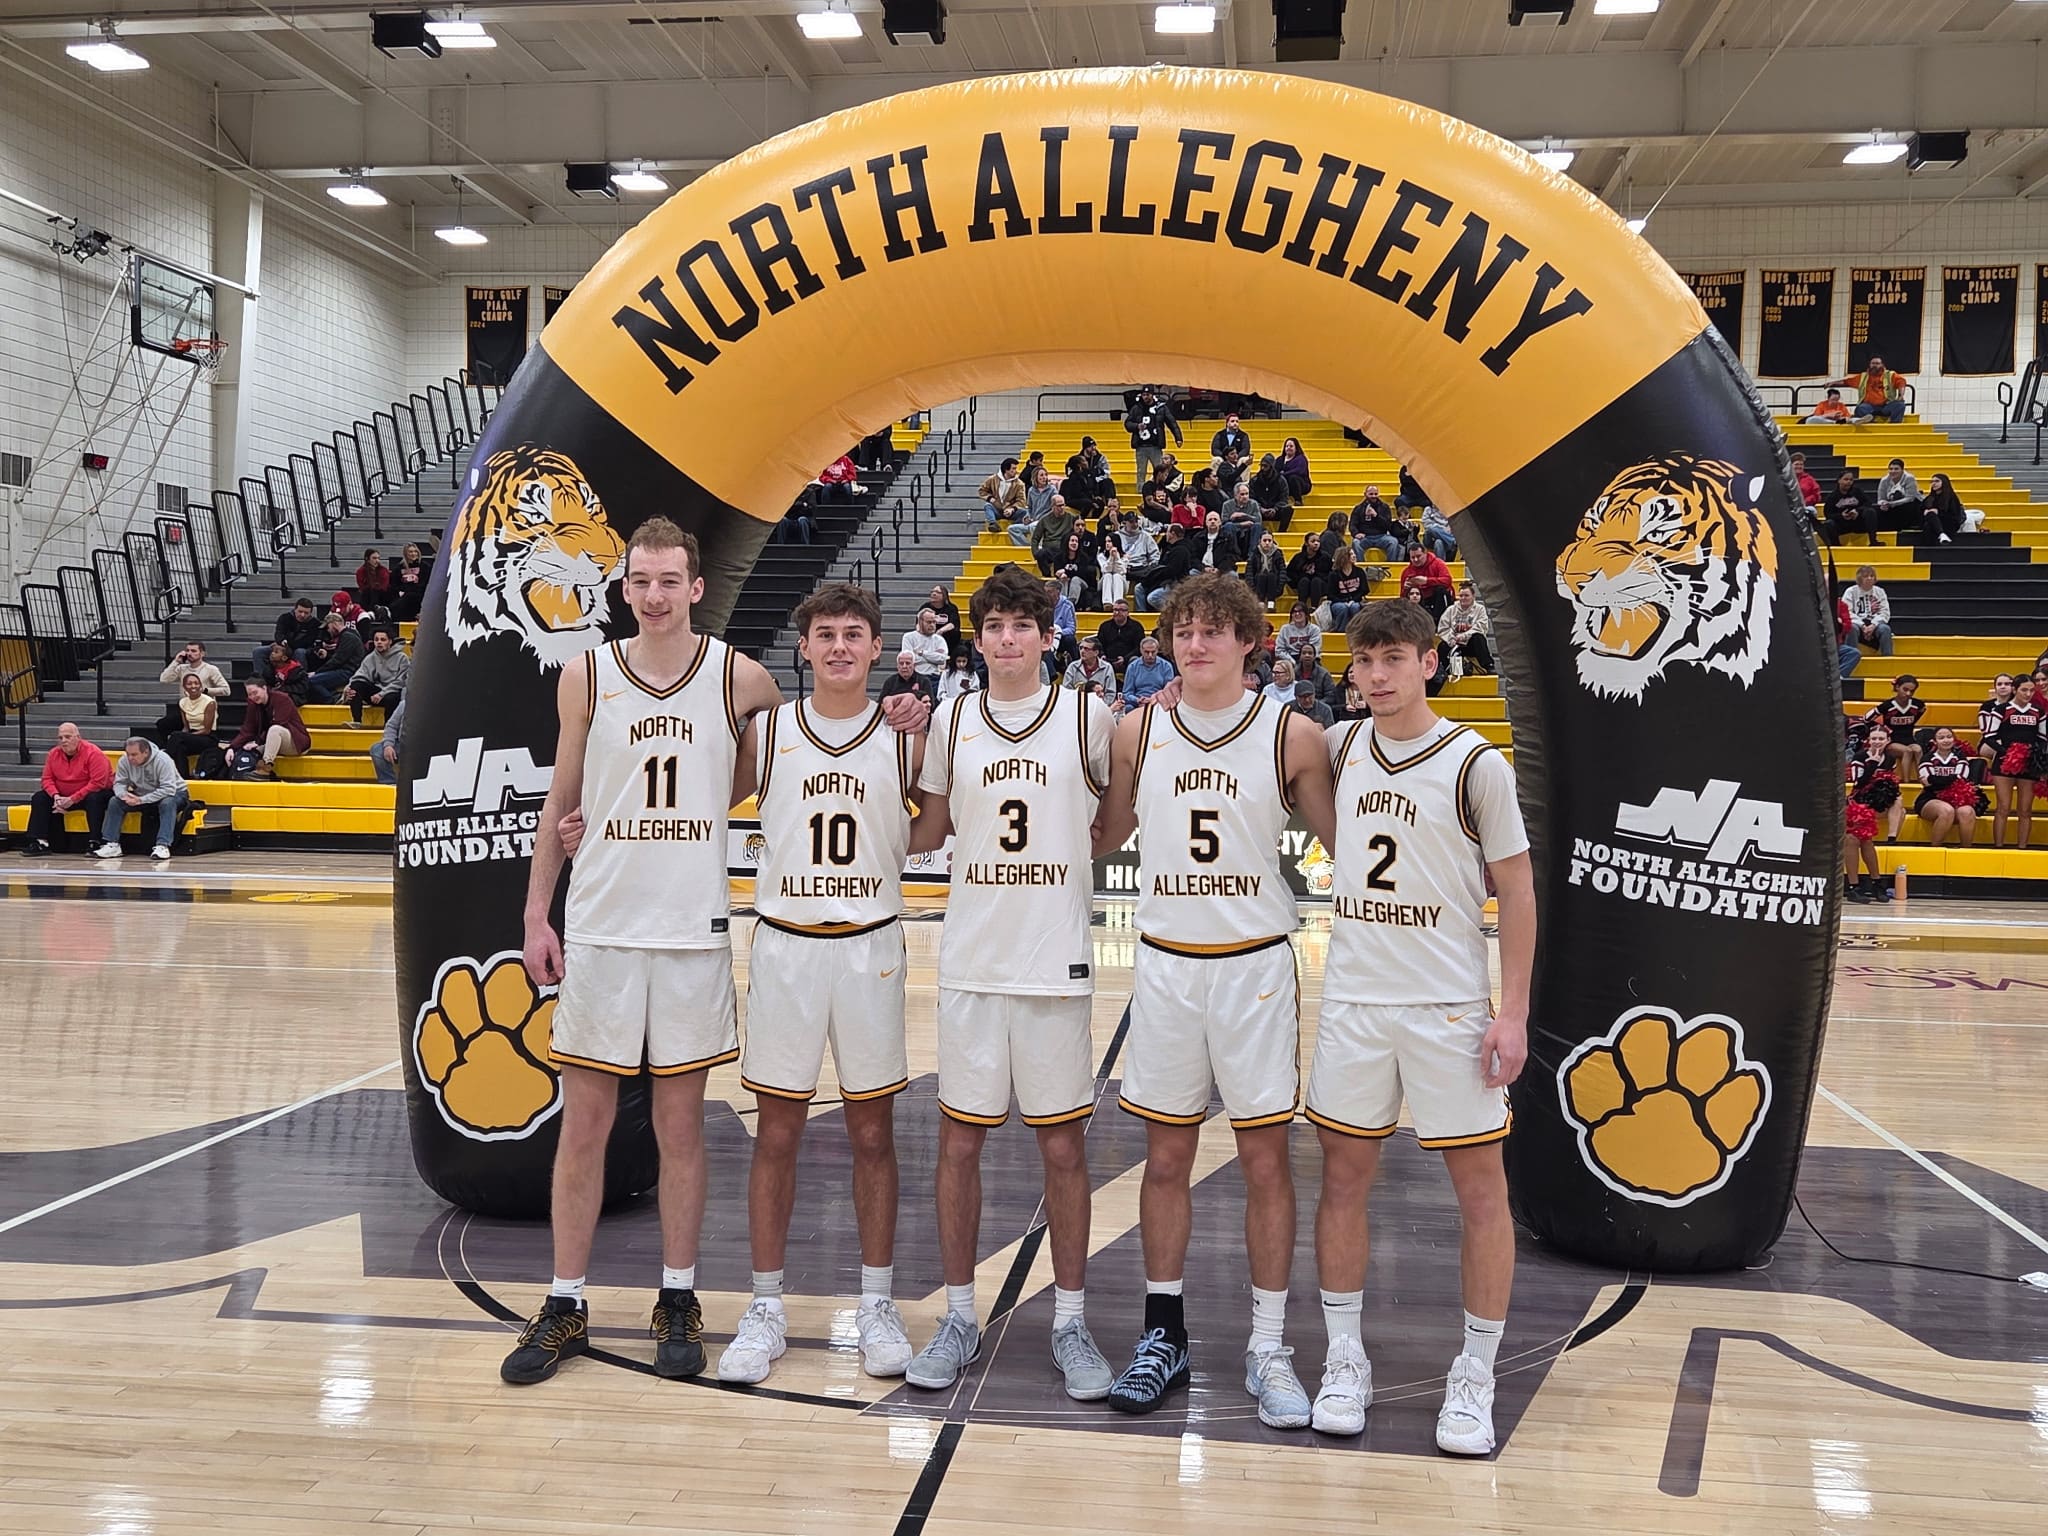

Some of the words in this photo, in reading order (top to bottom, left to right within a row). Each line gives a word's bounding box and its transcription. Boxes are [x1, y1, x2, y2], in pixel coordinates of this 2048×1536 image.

[612, 145, 947, 395] NORTH
[967, 125, 1594, 376] ALLEGHENY
[1700, 273, 1742, 286] BASKETBALL
[1764, 273, 1789, 283] BOYS
[1797, 272, 1831, 283] TENNIS
[1853, 270, 1881, 281] GIRLS
[1889, 269, 1924, 281] TENNIS
[1944, 269, 1971, 280] BOYS
[1979, 268, 2016, 279] SOCCER
[472, 290, 494, 300] BOYS
[500, 289, 522, 300] GOLF
[1696, 286, 1720, 297] PIAA
[1784, 284, 1809, 294] PIAA
[1874, 281, 1901, 292] PIAA
[1960, 292, 2000, 304] CHAMPS
[1968, 281, 1993, 292] PIAA
[486, 300, 508, 311] PIAA
[1698, 297, 1727, 308] AMPS
[1777, 295, 1816, 306] CHAMPS
[1867, 293, 1907, 304] CHAMPS
[481, 311, 513, 321] CHAMPS
[629, 715, 693, 746] NORTH
[2009, 714, 2037, 726] CANES
[643, 755, 679, 809] 11
[983, 758, 1047, 787] NORTH
[1174, 767, 1238, 800] NORTH
[802, 772, 865, 803] NORTH
[1356, 791, 1417, 827] NORTH
[398, 819, 452, 841] NORTH
[456, 810, 542, 836] ALLEG
[604, 819, 713, 842] ALLEGHENY
[998, 799, 1029, 853] 3
[1189, 808, 1221, 864] 5
[808, 812, 857, 866] 10
[1366, 833, 1397, 892] 2
[1573, 838, 1673, 876] NORTH
[1676, 857, 1827, 897] ALLEGHENY
[965, 863, 1068, 886] ALLEGHENY
[1106, 865, 1140, 889] HI
[1153, 874, 1261, 897] ALLEGHENY
[779, 876, 883, 899] ALLEGHENY
[1568, 858, 1824, 926] FOUNDATION
[1334, 896, 1441, 928] ALLEGHENY
